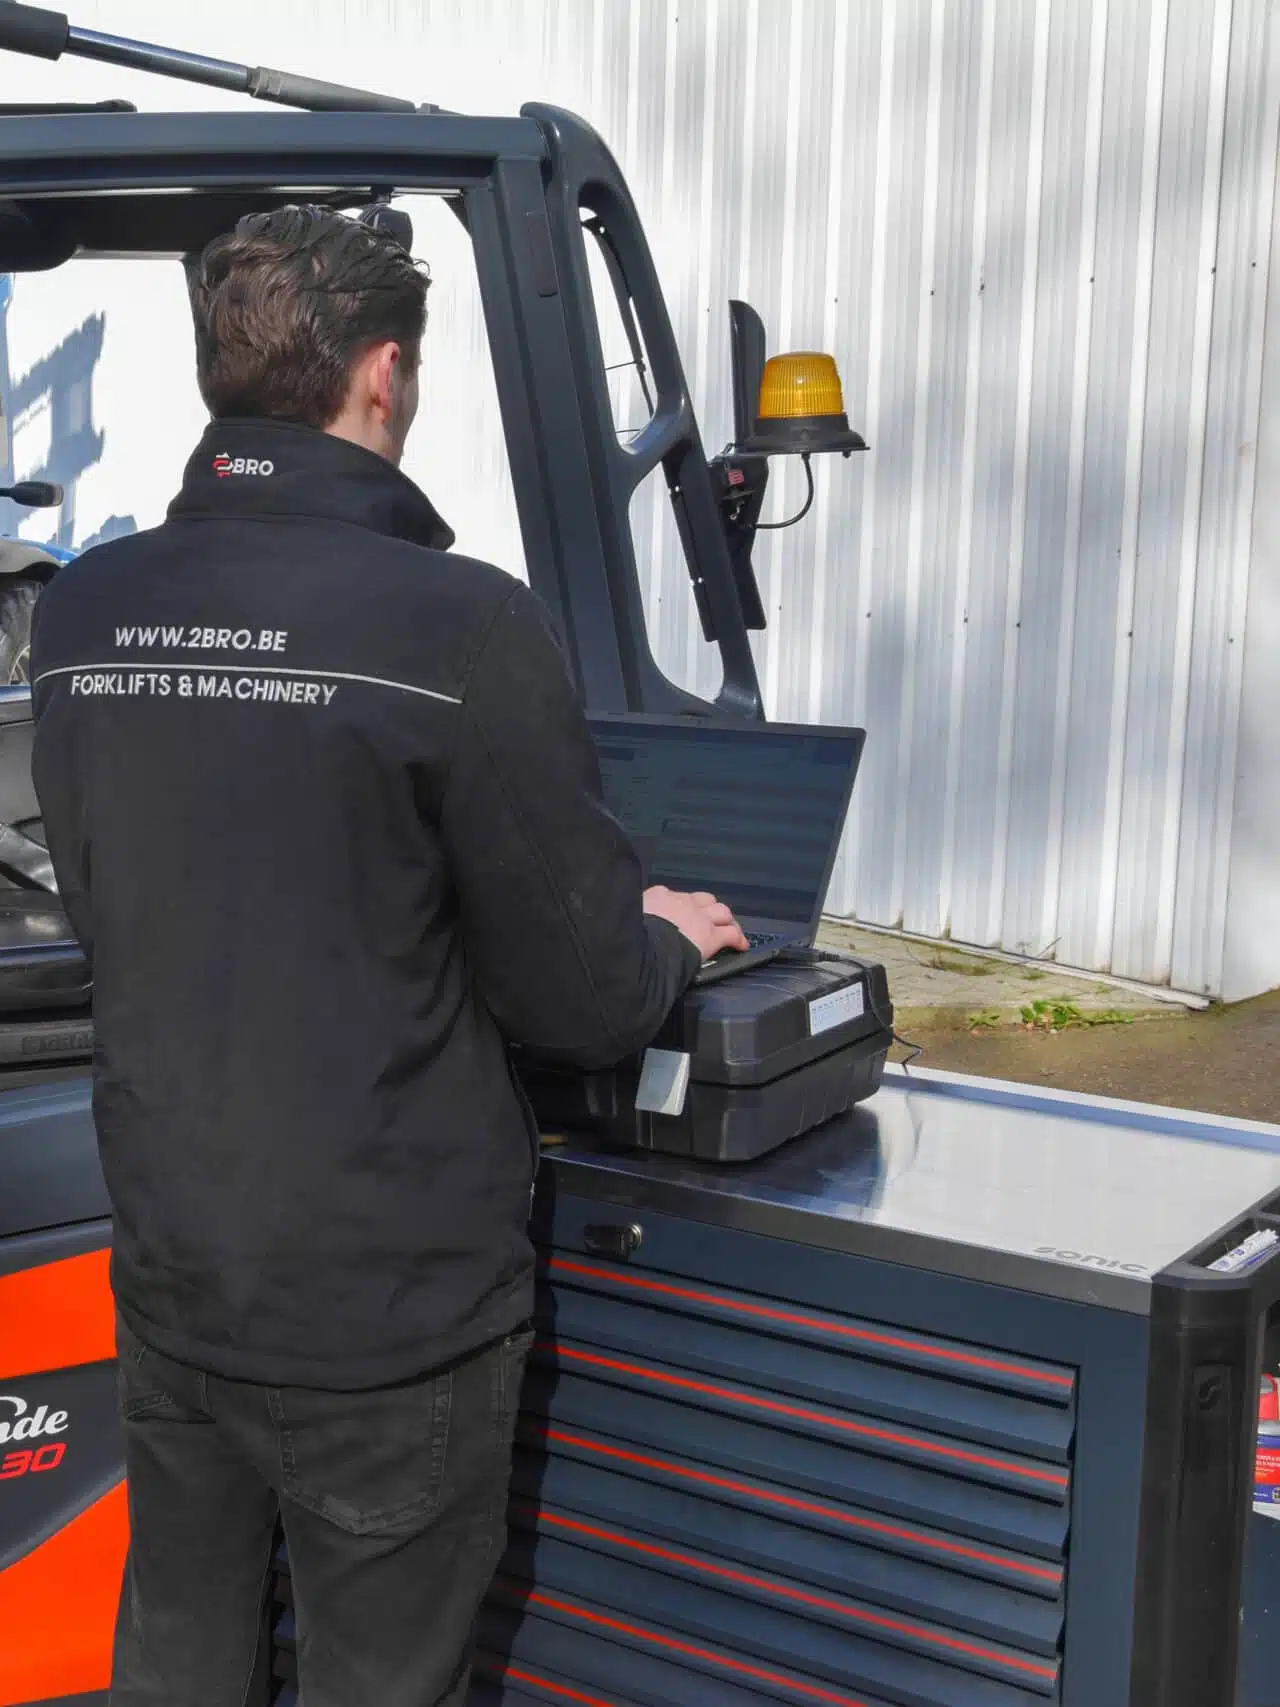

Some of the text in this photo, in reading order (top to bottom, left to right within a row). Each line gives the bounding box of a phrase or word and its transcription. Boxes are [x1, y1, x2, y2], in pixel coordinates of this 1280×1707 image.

[115, 626, 288, 652] WWW.2BRO.BE
[71, 673, 338, 706] FORKLIFTS & MACHINERY
